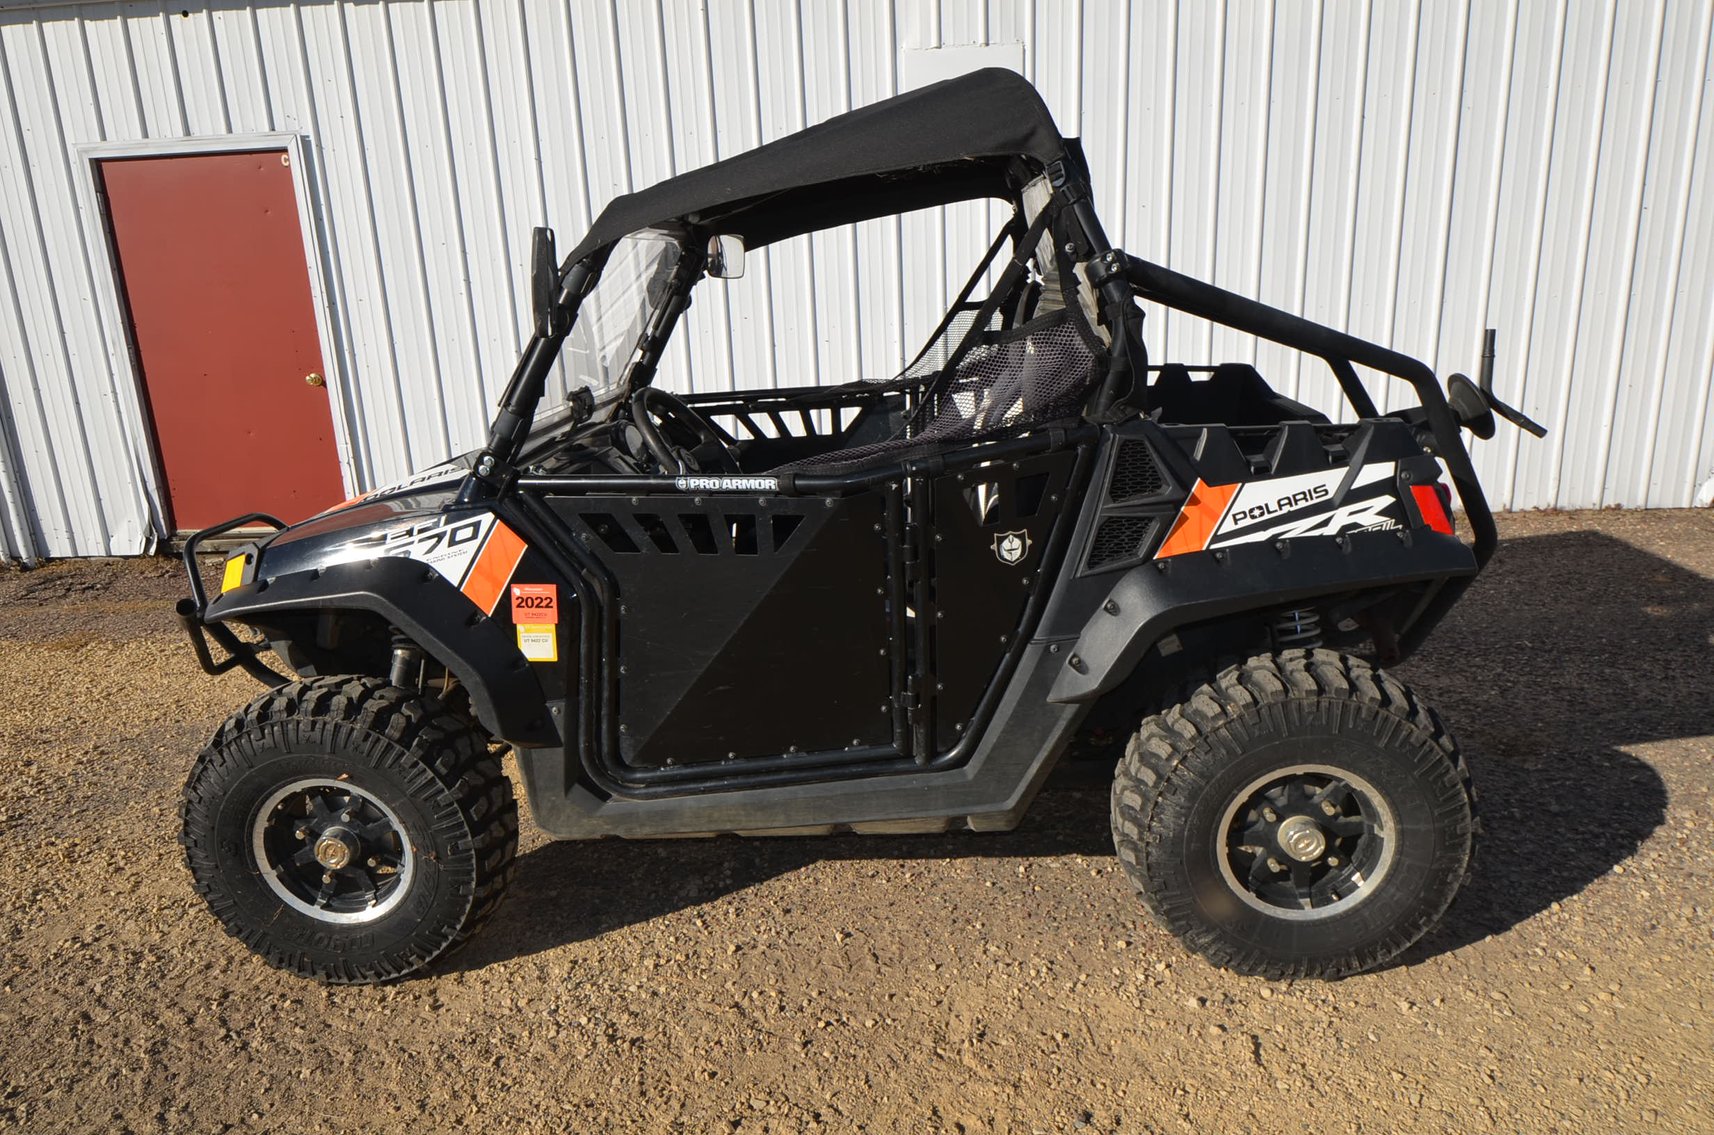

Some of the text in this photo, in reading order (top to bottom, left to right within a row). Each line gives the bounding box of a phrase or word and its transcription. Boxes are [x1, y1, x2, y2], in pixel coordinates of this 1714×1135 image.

[689, 478, 776, 490] PRO ARMOR
[1231, 483, 1330, 526] POLARIS
[515, 596, 554, 609] 2022
